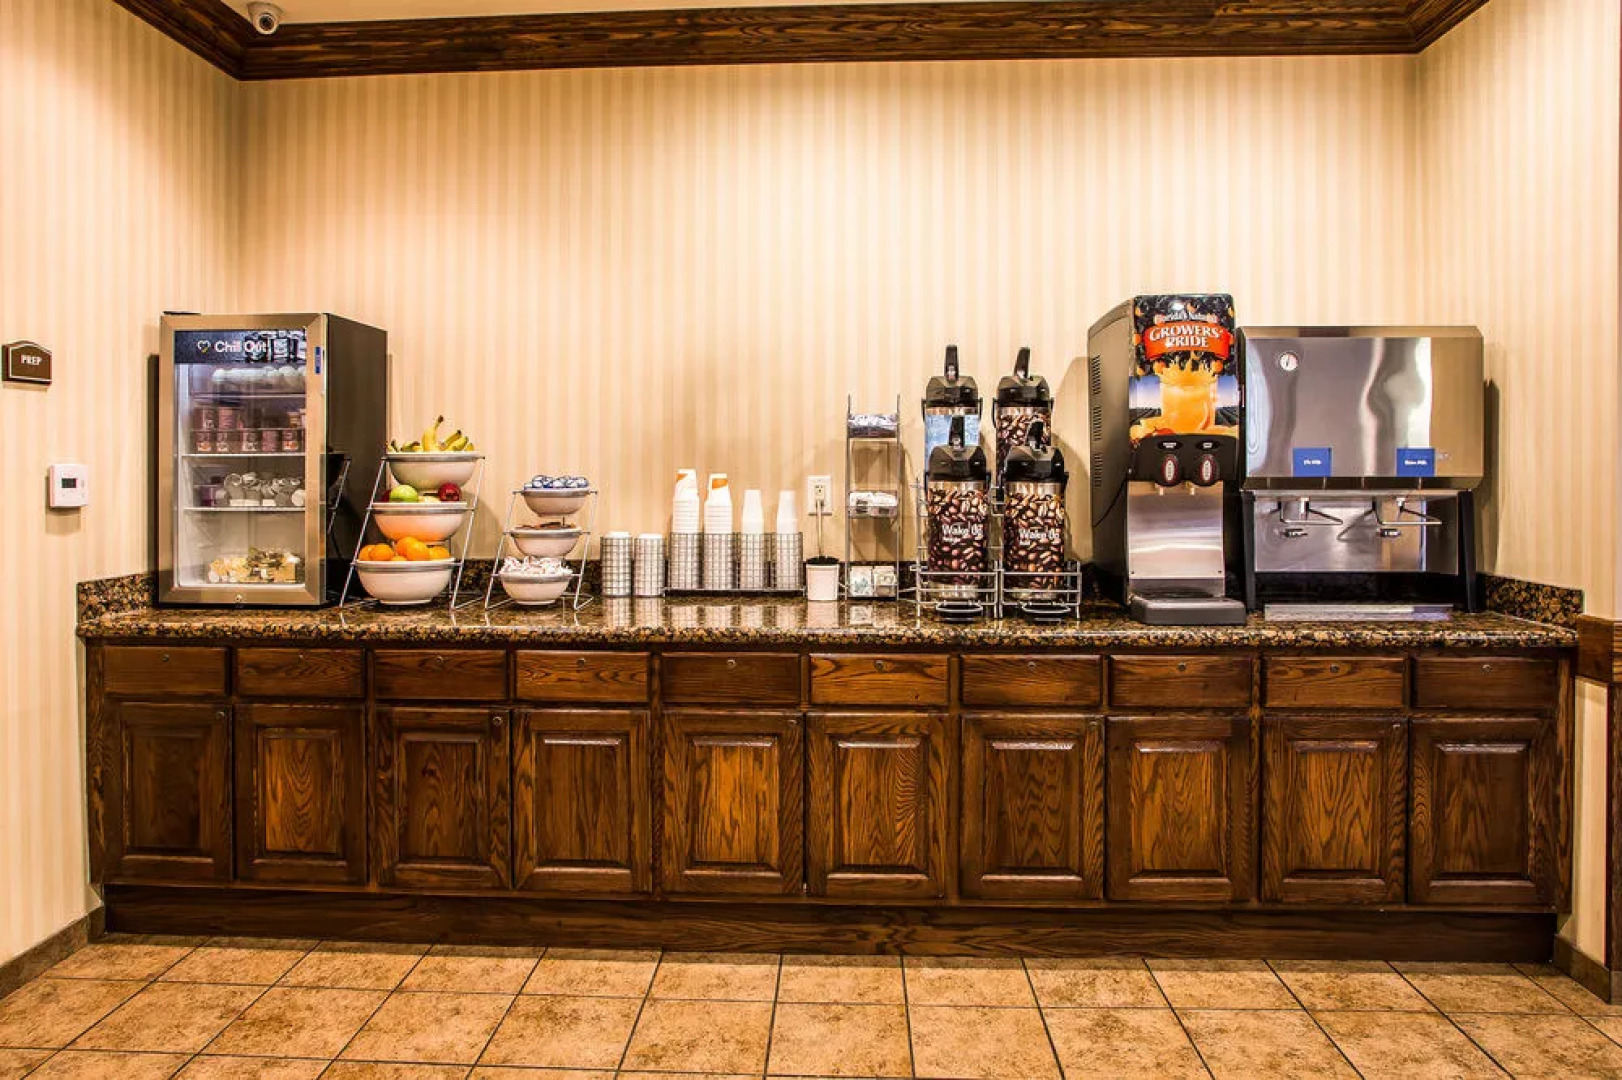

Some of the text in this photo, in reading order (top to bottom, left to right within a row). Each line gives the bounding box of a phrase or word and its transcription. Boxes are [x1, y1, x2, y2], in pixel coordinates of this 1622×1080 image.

[214, 340, 242, 353] Chill
[1165, 335, 1209, 348] PRIDE
[20, 354, 43, 366] PREP
[942, 524, 969, 536] Wake
